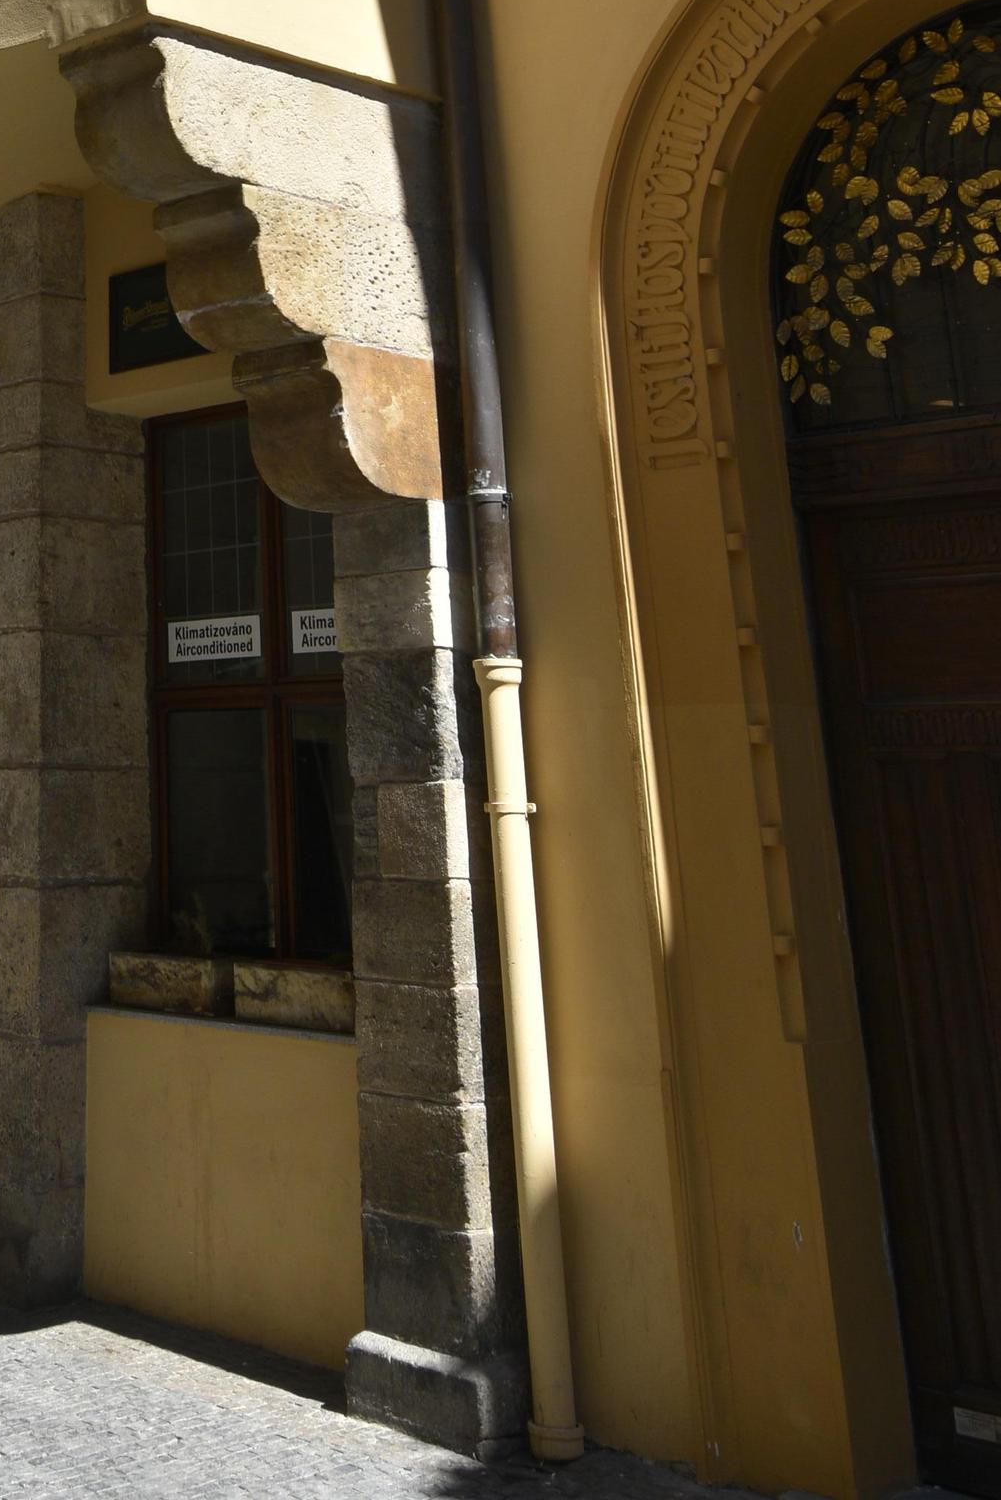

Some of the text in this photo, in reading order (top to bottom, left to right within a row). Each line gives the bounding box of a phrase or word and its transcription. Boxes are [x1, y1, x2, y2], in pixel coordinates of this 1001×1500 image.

[174, 622, 253, 640] Klimatizováno
[300, 615, 335, 631] Klima
[175, 638, 253, 657] Airconditioned
